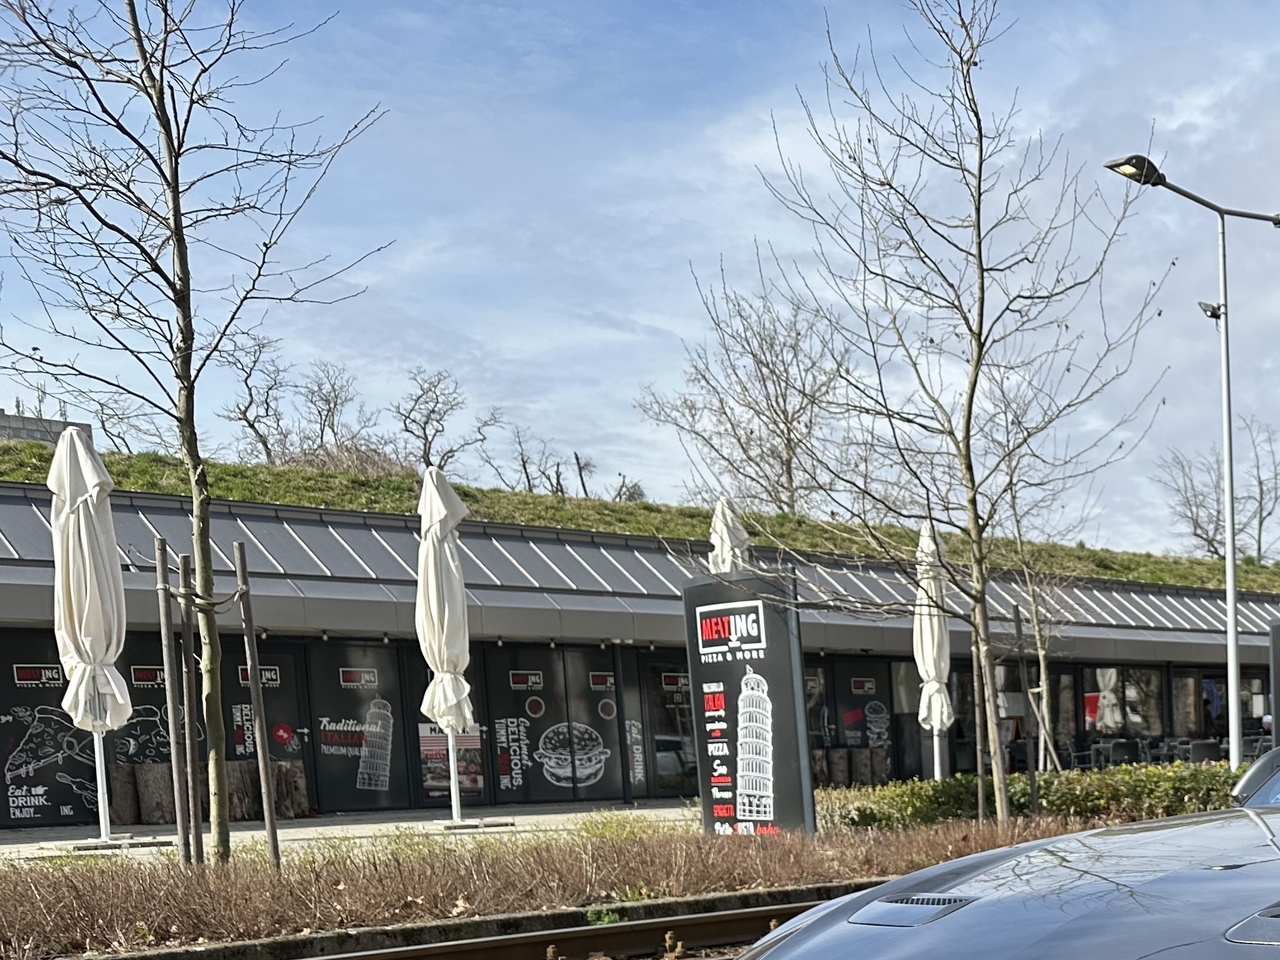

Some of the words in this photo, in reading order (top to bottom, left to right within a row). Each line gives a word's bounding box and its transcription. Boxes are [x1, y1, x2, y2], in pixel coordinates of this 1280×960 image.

[702, 613, 759, 642] MEATING
[701, 653, 724, 663] PIZZA
[726, 652, 733, 661] &
[736, 650, 765, 660] MORE
[707, 742, 730, 756] PIZZA
[9, 796, 52, 807] DRINK.
